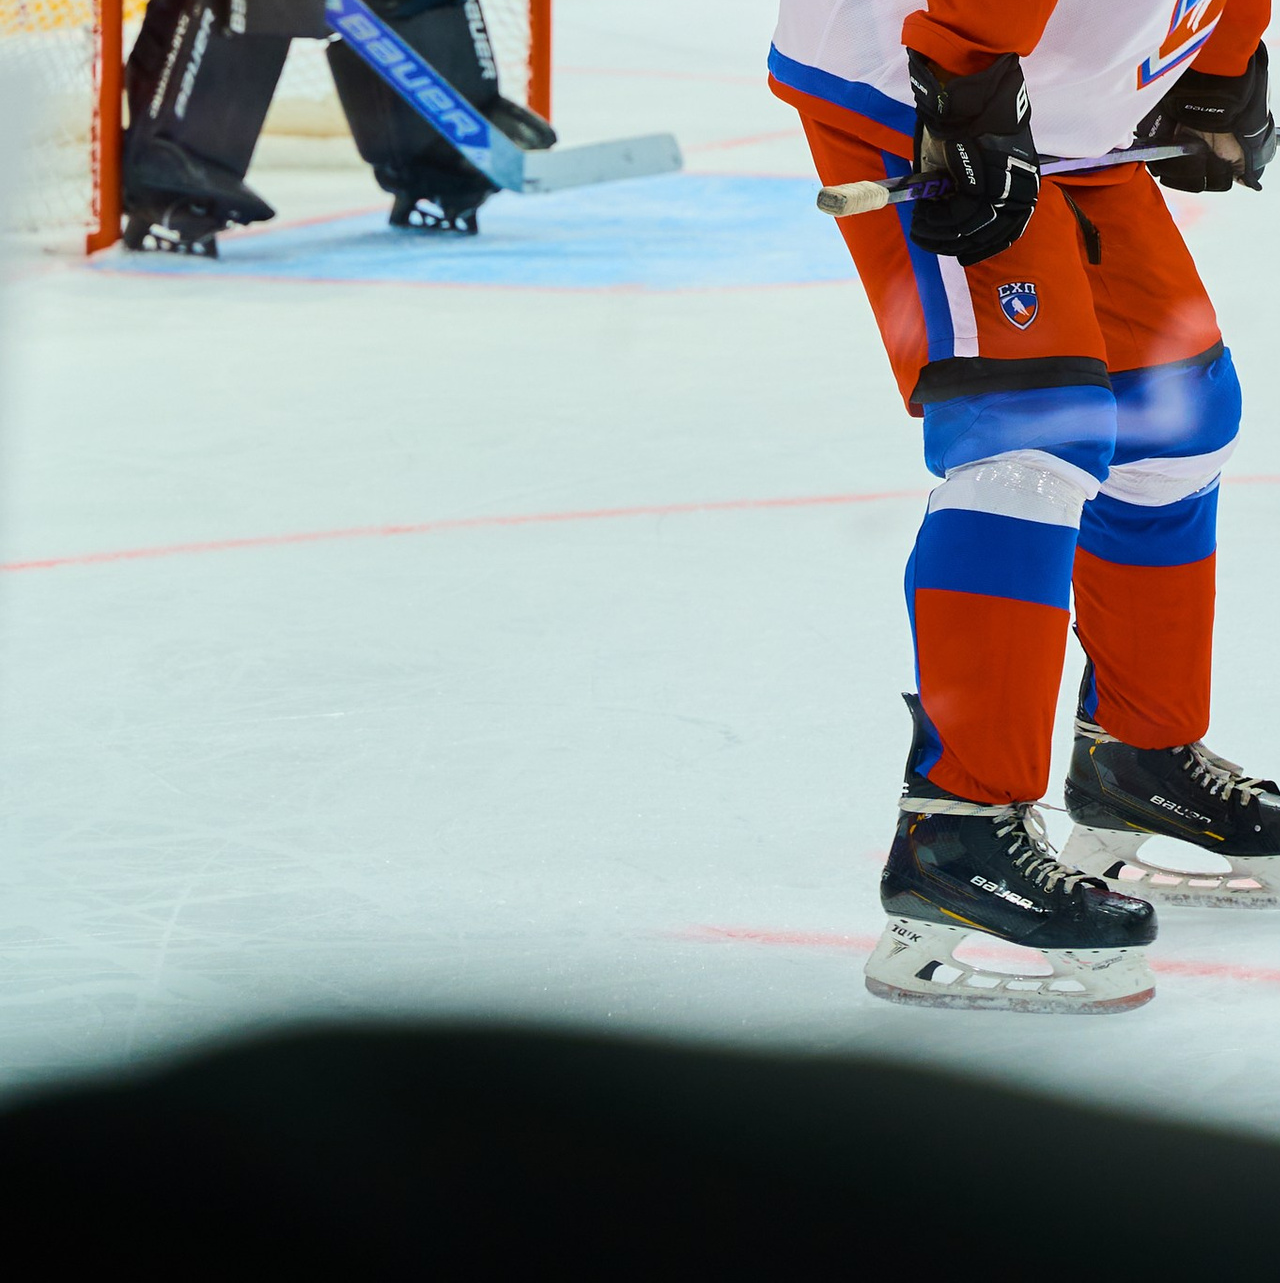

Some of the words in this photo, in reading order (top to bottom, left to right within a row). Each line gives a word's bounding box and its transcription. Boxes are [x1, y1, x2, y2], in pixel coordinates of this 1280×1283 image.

[337, 12, 481, 140] BAUER
[1184, 103, 1226, 114] BAUER
[956, 142, 978, 186] BAUER
[997, 282, 1037, 298] СХП
[970, 875, 1035, 910] BAUER
